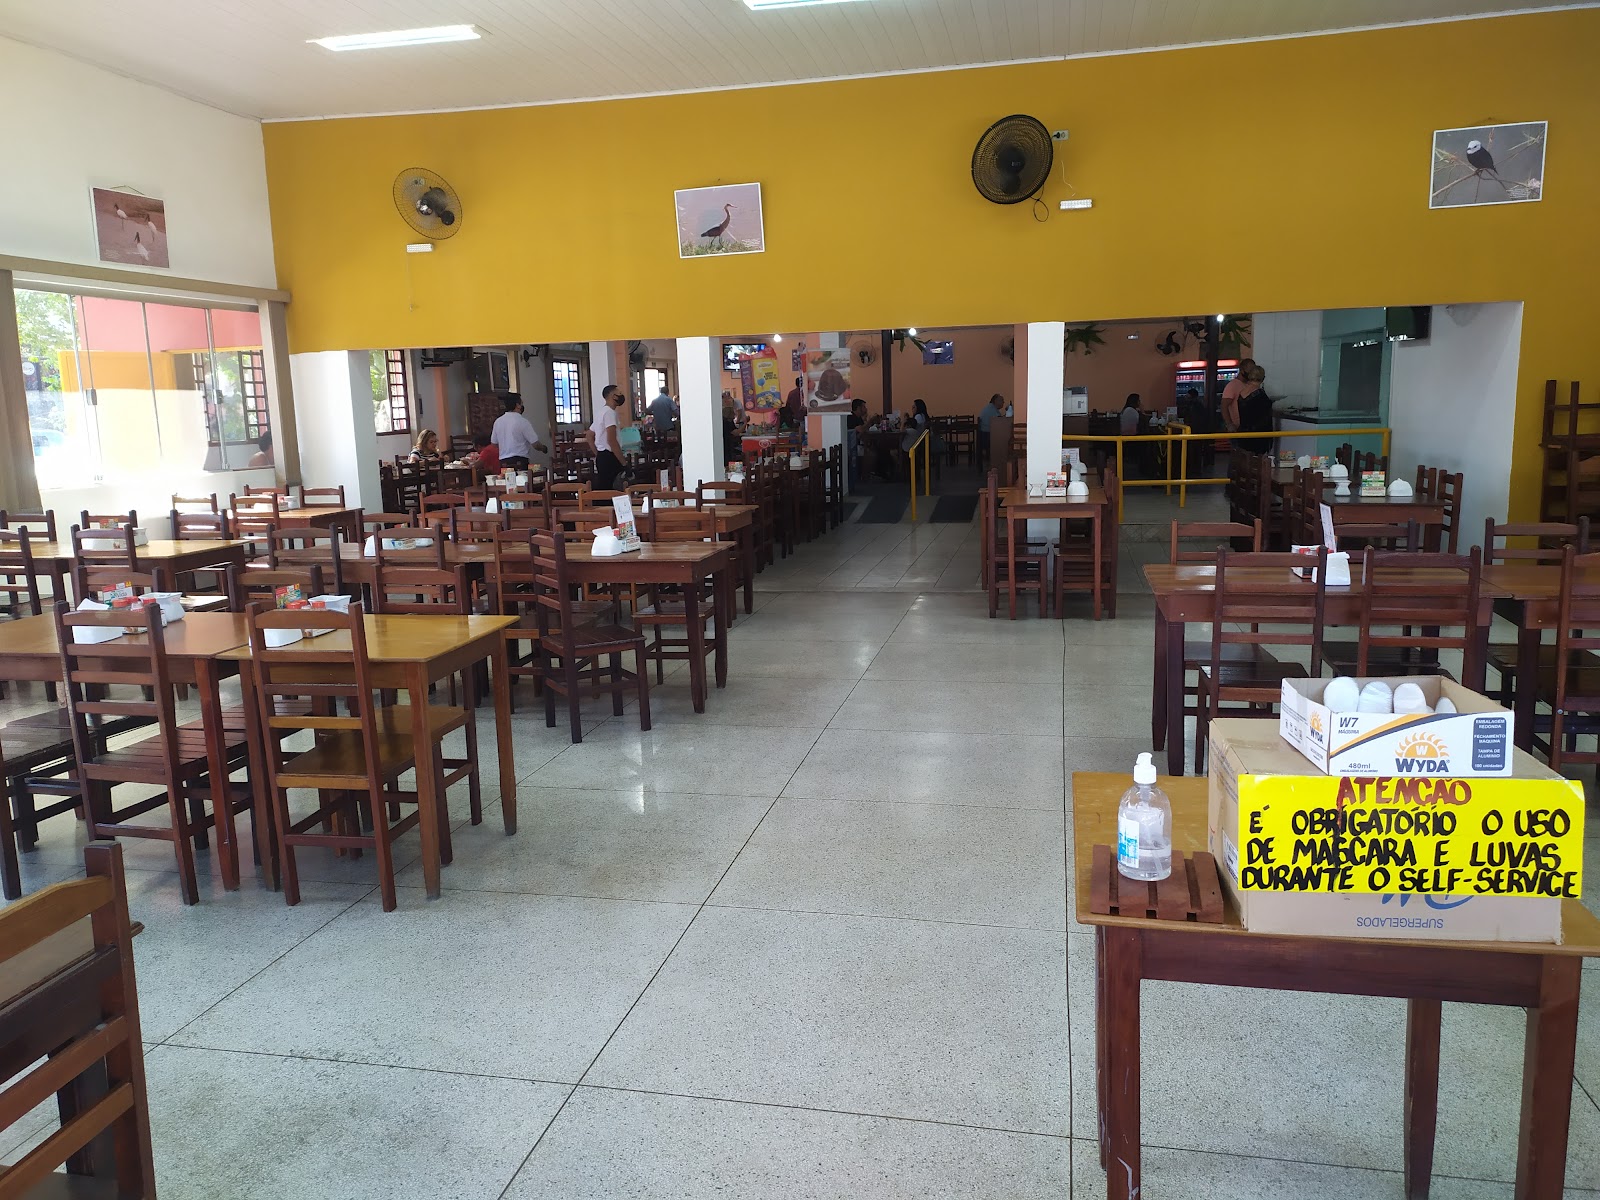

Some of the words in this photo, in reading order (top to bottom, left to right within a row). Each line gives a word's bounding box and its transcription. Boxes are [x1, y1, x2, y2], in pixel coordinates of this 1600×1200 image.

[1339, 716, 1359, 728] W7
[1415, 745, 1429, 756] W
[1395, 758, 1449, 773] WYDA
[1481, 809, 1504, 836] O
[1513, 808, 1571, 838] USO
[1246, 837, 1277, 866] DE
[1433, 839, 1451, 867] E
[1469, 841, 1562, 873] LUVAS
[1241, 864, 1355, 893] DURANTE
[1368, 867, 1391, 891] O
[1398, 867, 1579, 898] SELF-SERVICE
[1356, 916, 1444, 929] SUPERGELADOS
